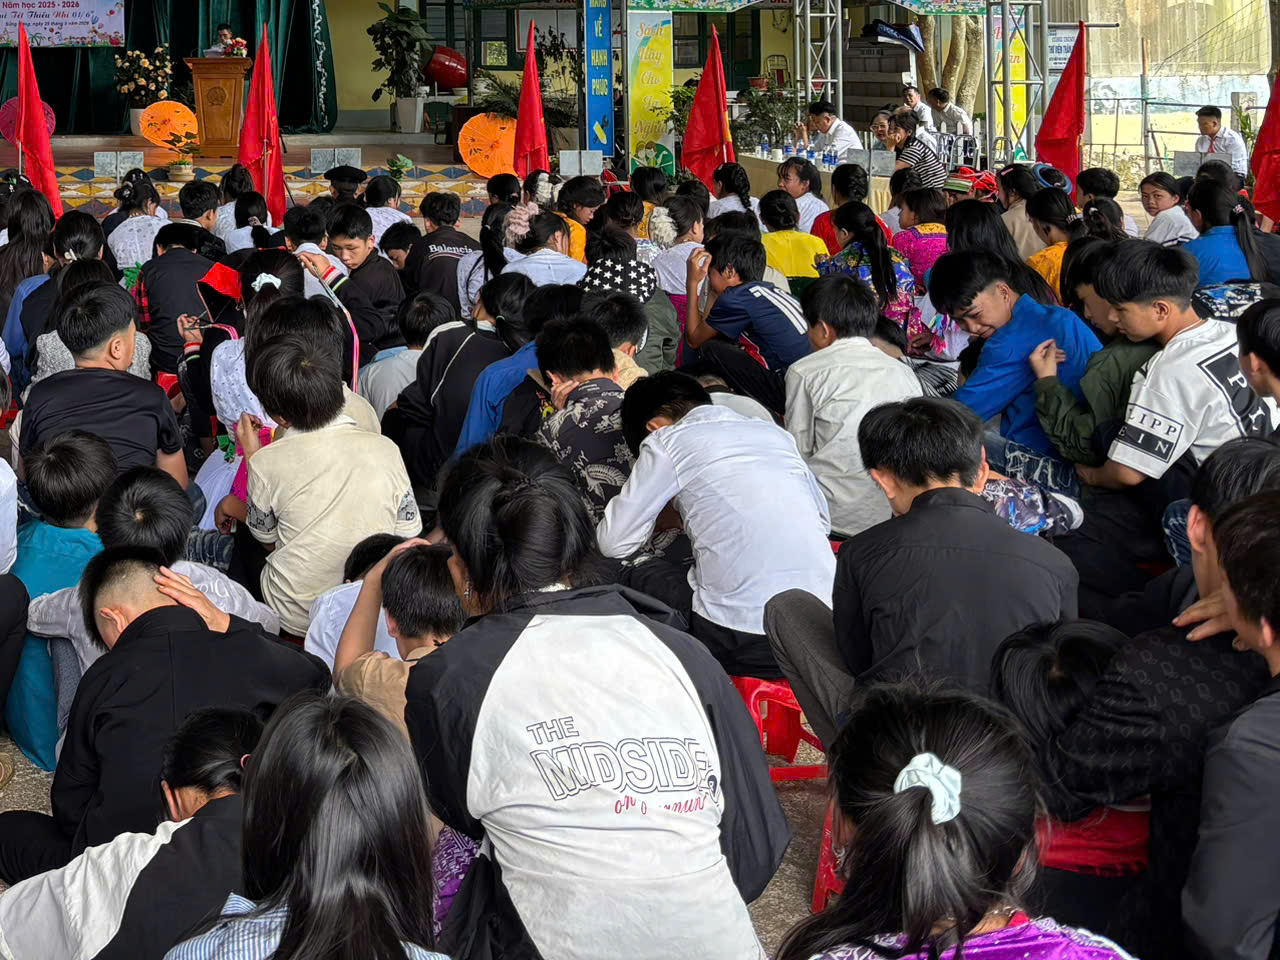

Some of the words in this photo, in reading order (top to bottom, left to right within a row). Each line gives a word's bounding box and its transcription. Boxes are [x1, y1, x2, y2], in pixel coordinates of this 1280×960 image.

[2, 1, 20, 9] Năm
[21, 1, 36, 11] học
[37, 1, 56, 9] 2025
[594, 12, 603, 38] VỀ
[635, 23, 665, 38] Sách
[591, 48, 609, 71] HẠNH
[591, 74, 609, 96] PHÚC
[526, 716, 580, 745] THE
